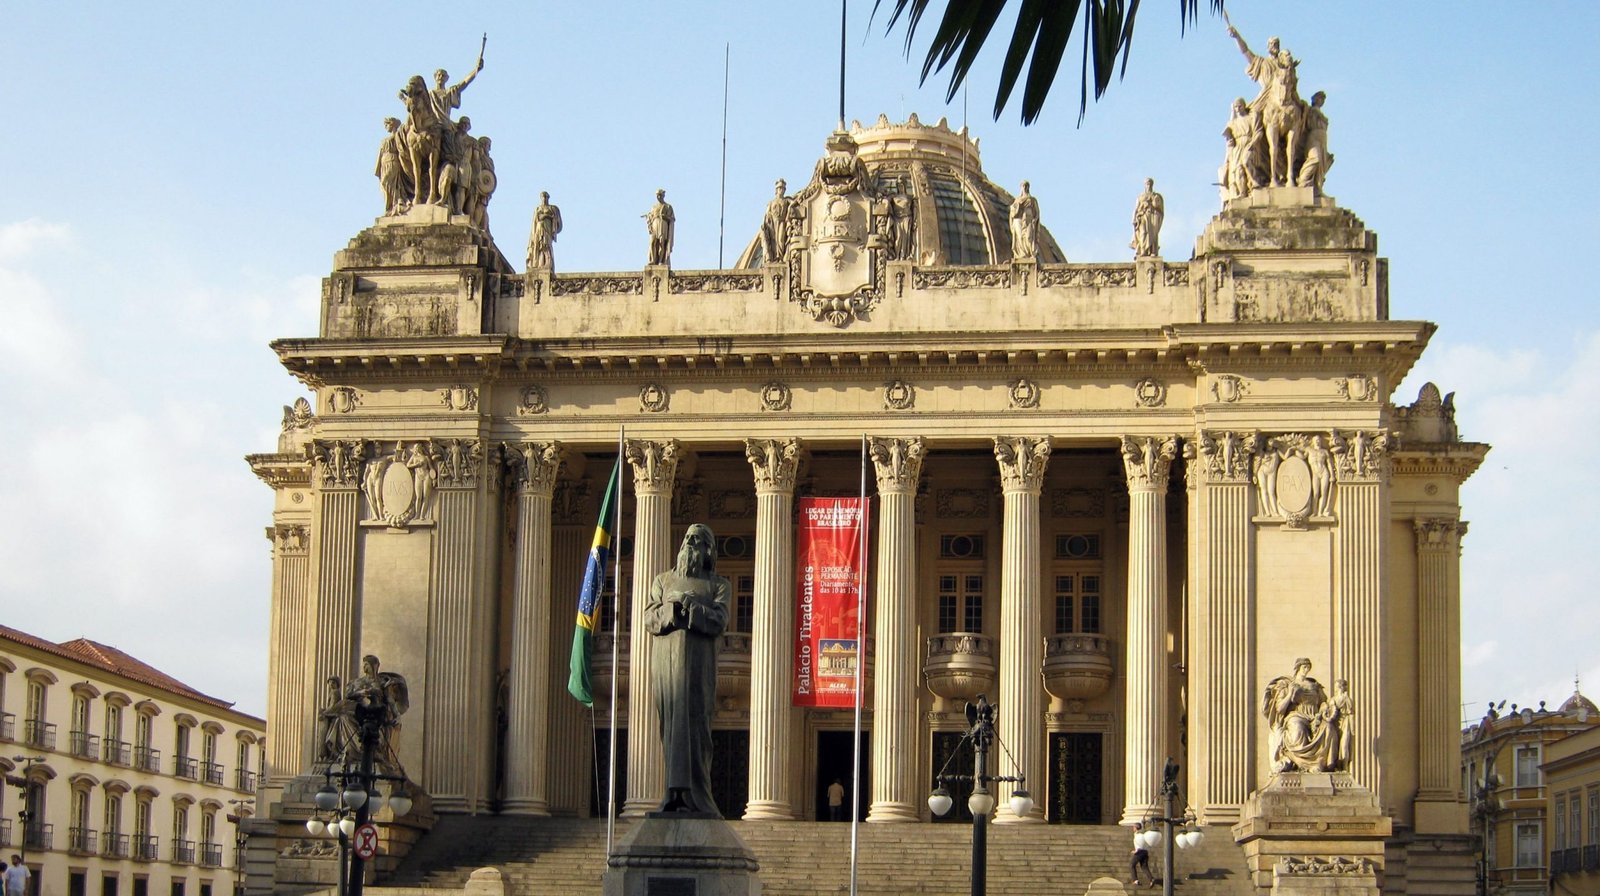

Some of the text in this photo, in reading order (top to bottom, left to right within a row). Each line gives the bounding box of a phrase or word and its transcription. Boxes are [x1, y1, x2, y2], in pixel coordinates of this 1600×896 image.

[1282, 475, 1305, 492] PAX
[798, 566, 814, 695] Palácio Tiradentes
